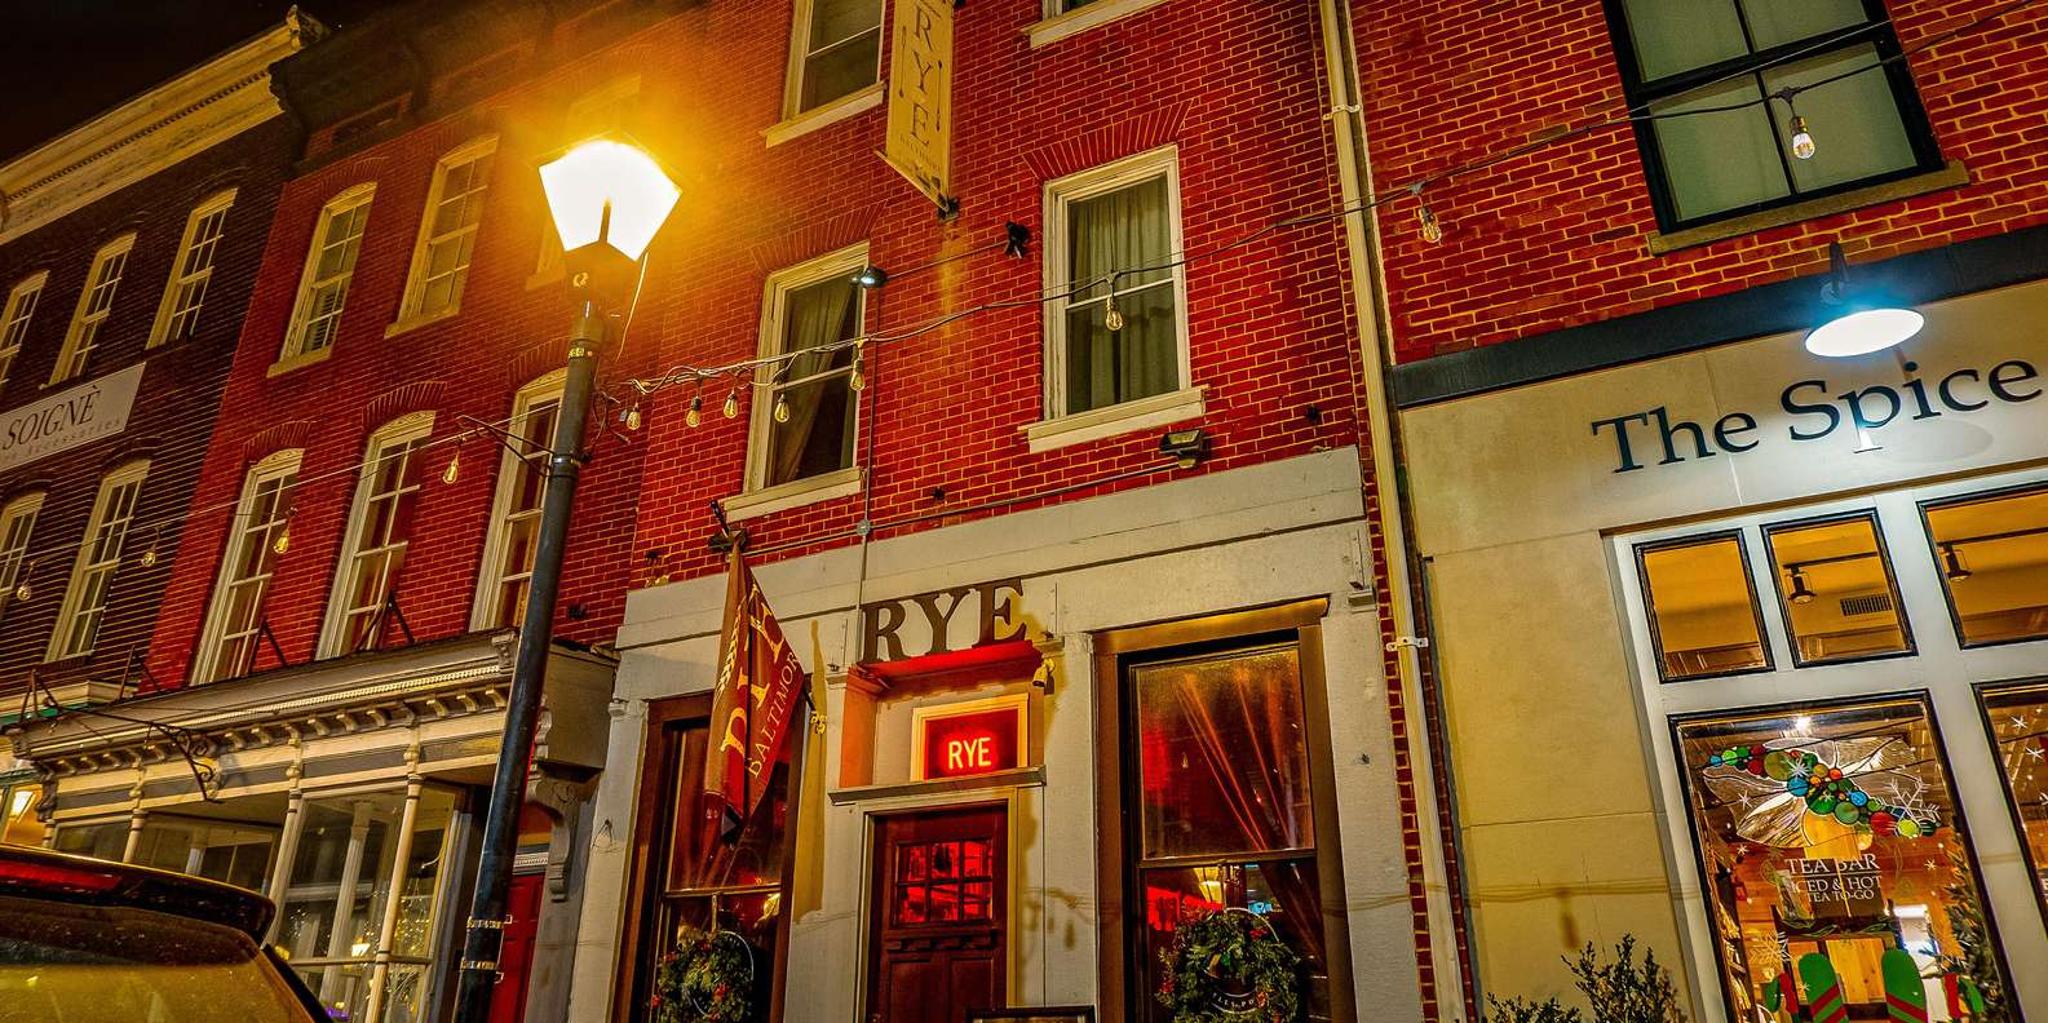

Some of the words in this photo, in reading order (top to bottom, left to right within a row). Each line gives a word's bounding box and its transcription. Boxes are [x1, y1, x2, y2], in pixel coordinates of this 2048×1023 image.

[910, 3, 935, 148] RYE
[1591, 404, 1761, 475] The
[1779, 358, 2045, 455] Spice
[856, 577, 1029, 666] RYE
[745, 651, 800, 780] BALTIMOR
[947, 736, 993, 771] RYE
[1784, 858, 1831, 875] TEA
[1790, 877, 1830, 893] ICED
[1832, 877, 1843, 891] &
[1847, 875, 1883, 891] HOT
[1809, 891, 1831, 903] TEA
[1832, 888, 1875, 902] TO-GO
